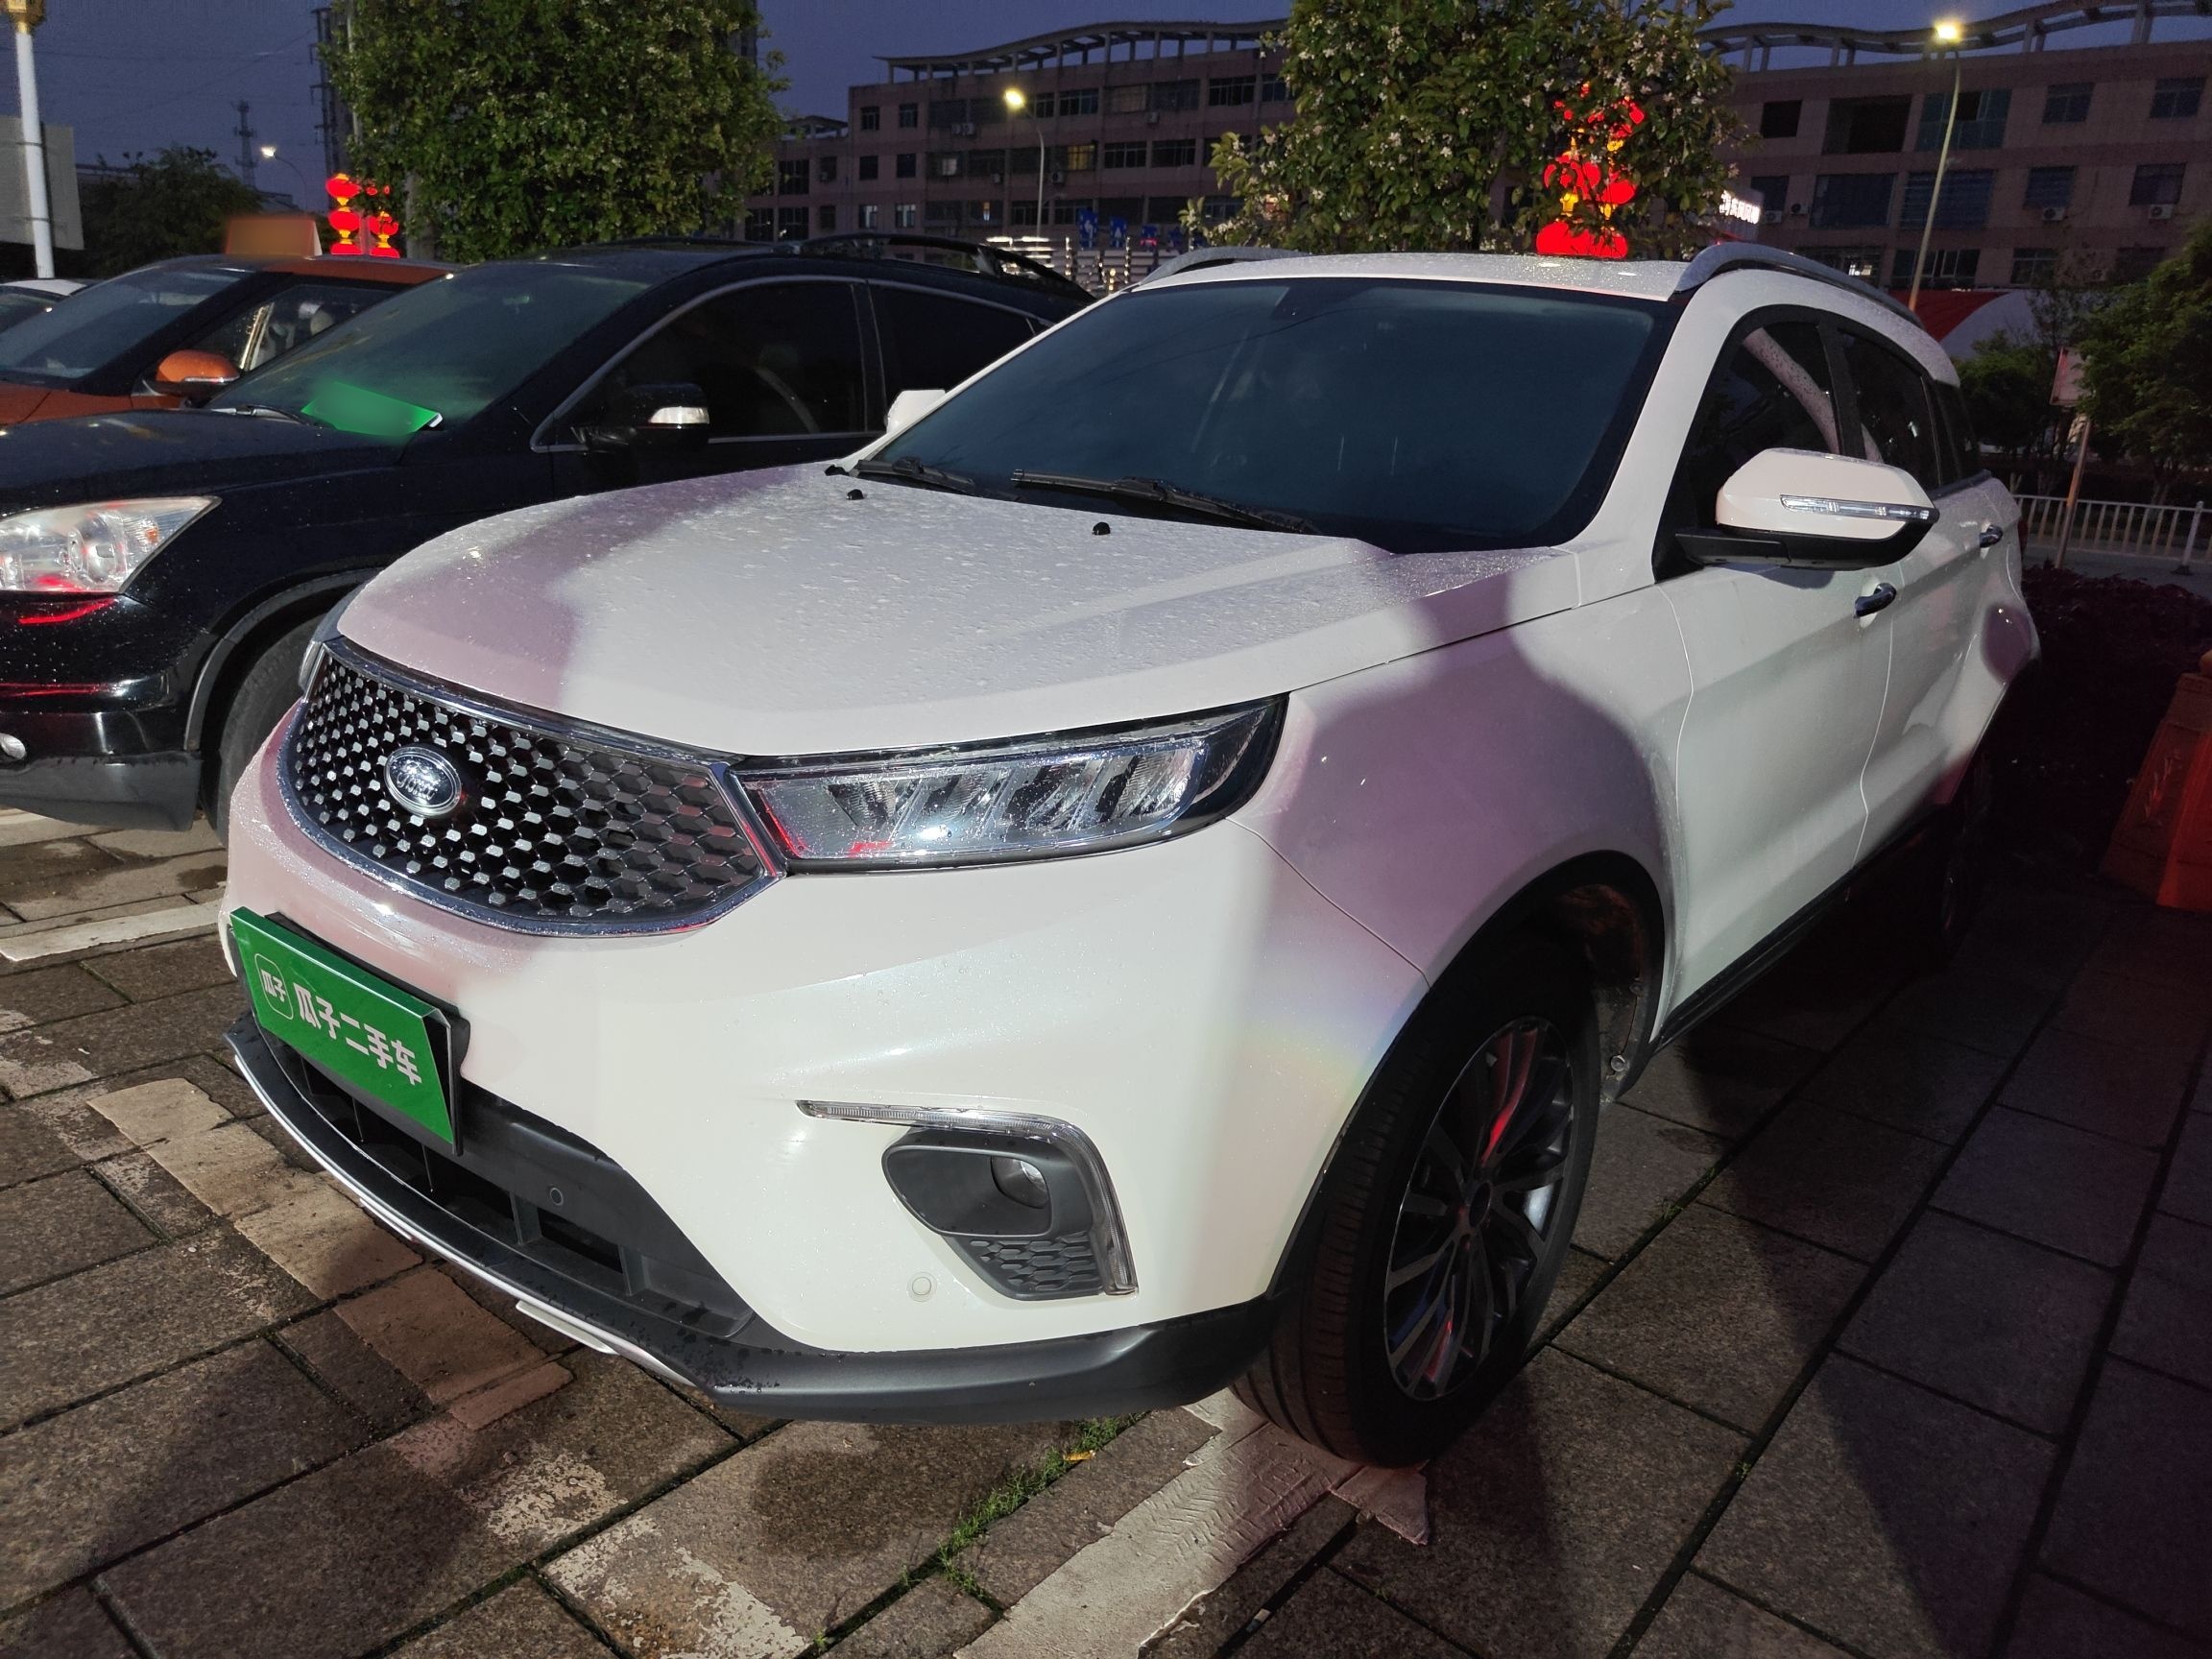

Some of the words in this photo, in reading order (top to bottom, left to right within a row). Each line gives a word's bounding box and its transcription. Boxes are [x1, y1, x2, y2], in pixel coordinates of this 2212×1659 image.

[260, 969, 287, 1003] 瓜子
[292, 982, 422, 1086] 瓜子二手车
